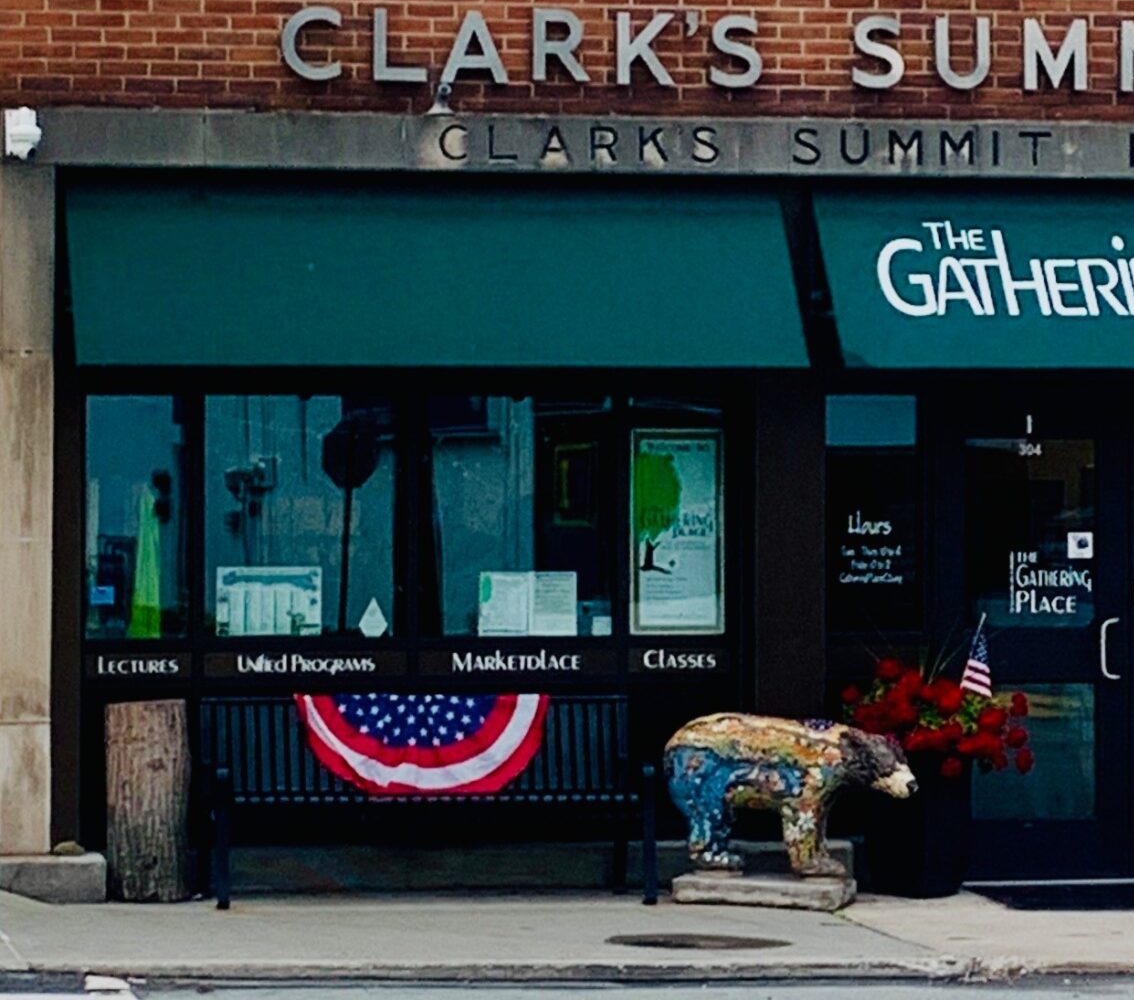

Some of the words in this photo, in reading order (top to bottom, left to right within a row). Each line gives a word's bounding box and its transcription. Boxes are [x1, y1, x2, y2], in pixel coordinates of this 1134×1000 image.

[281, 6, 764, 89] CLARK'S
[792, 125, 1053, 166] SUMMIT
[922, 220, 987, 252] THE
[1015, 588, 1077, 614] PLACE
